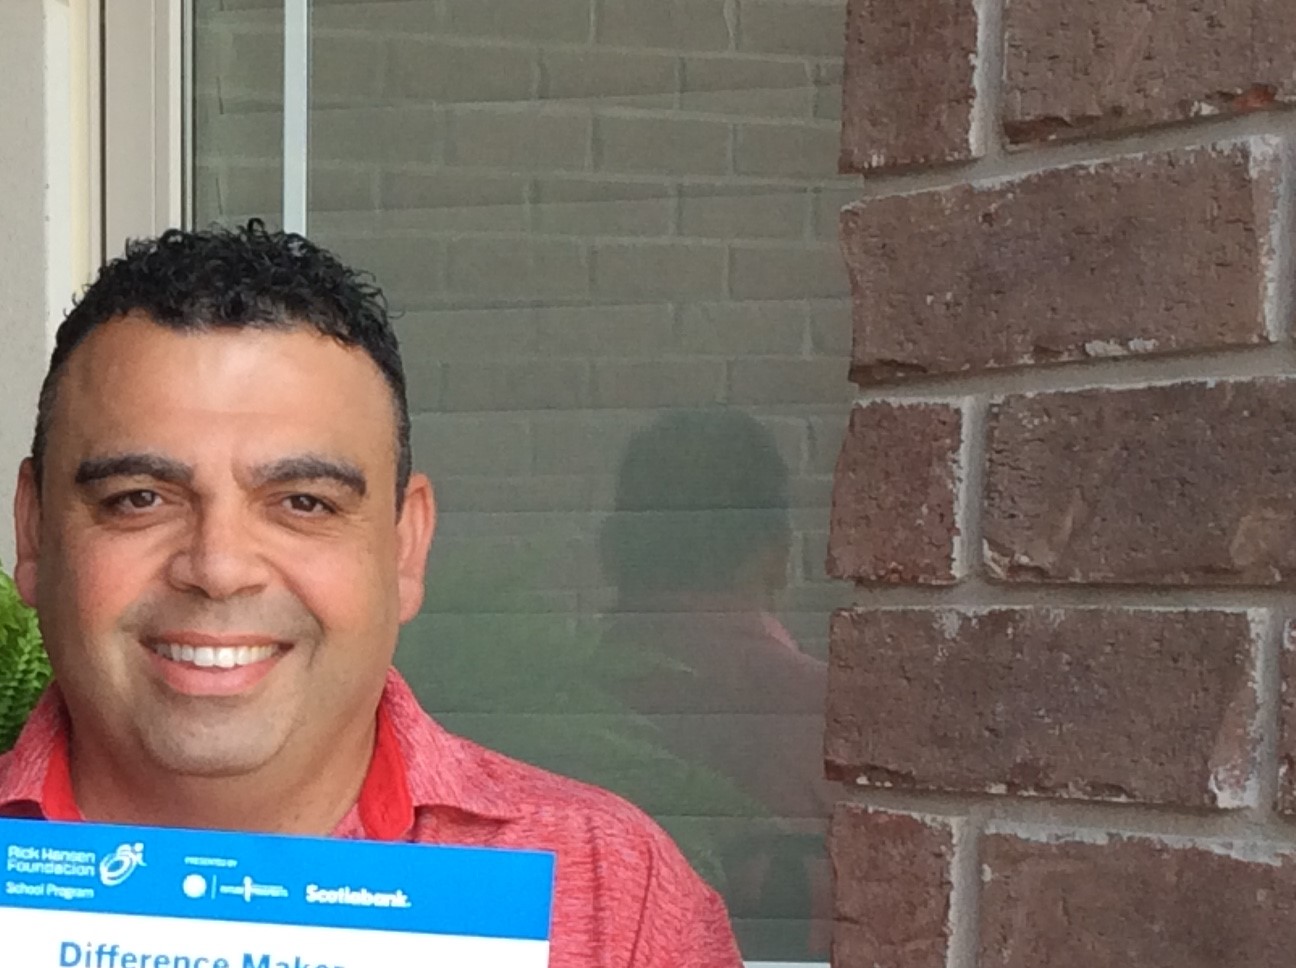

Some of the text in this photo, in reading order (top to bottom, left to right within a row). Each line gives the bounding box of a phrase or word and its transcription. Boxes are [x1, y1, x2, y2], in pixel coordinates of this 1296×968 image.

[7, 844, 95, 863] Rick Hansen
[7, 859, 95, 877] Foundation
[5, 881, 95, 900] School Program
